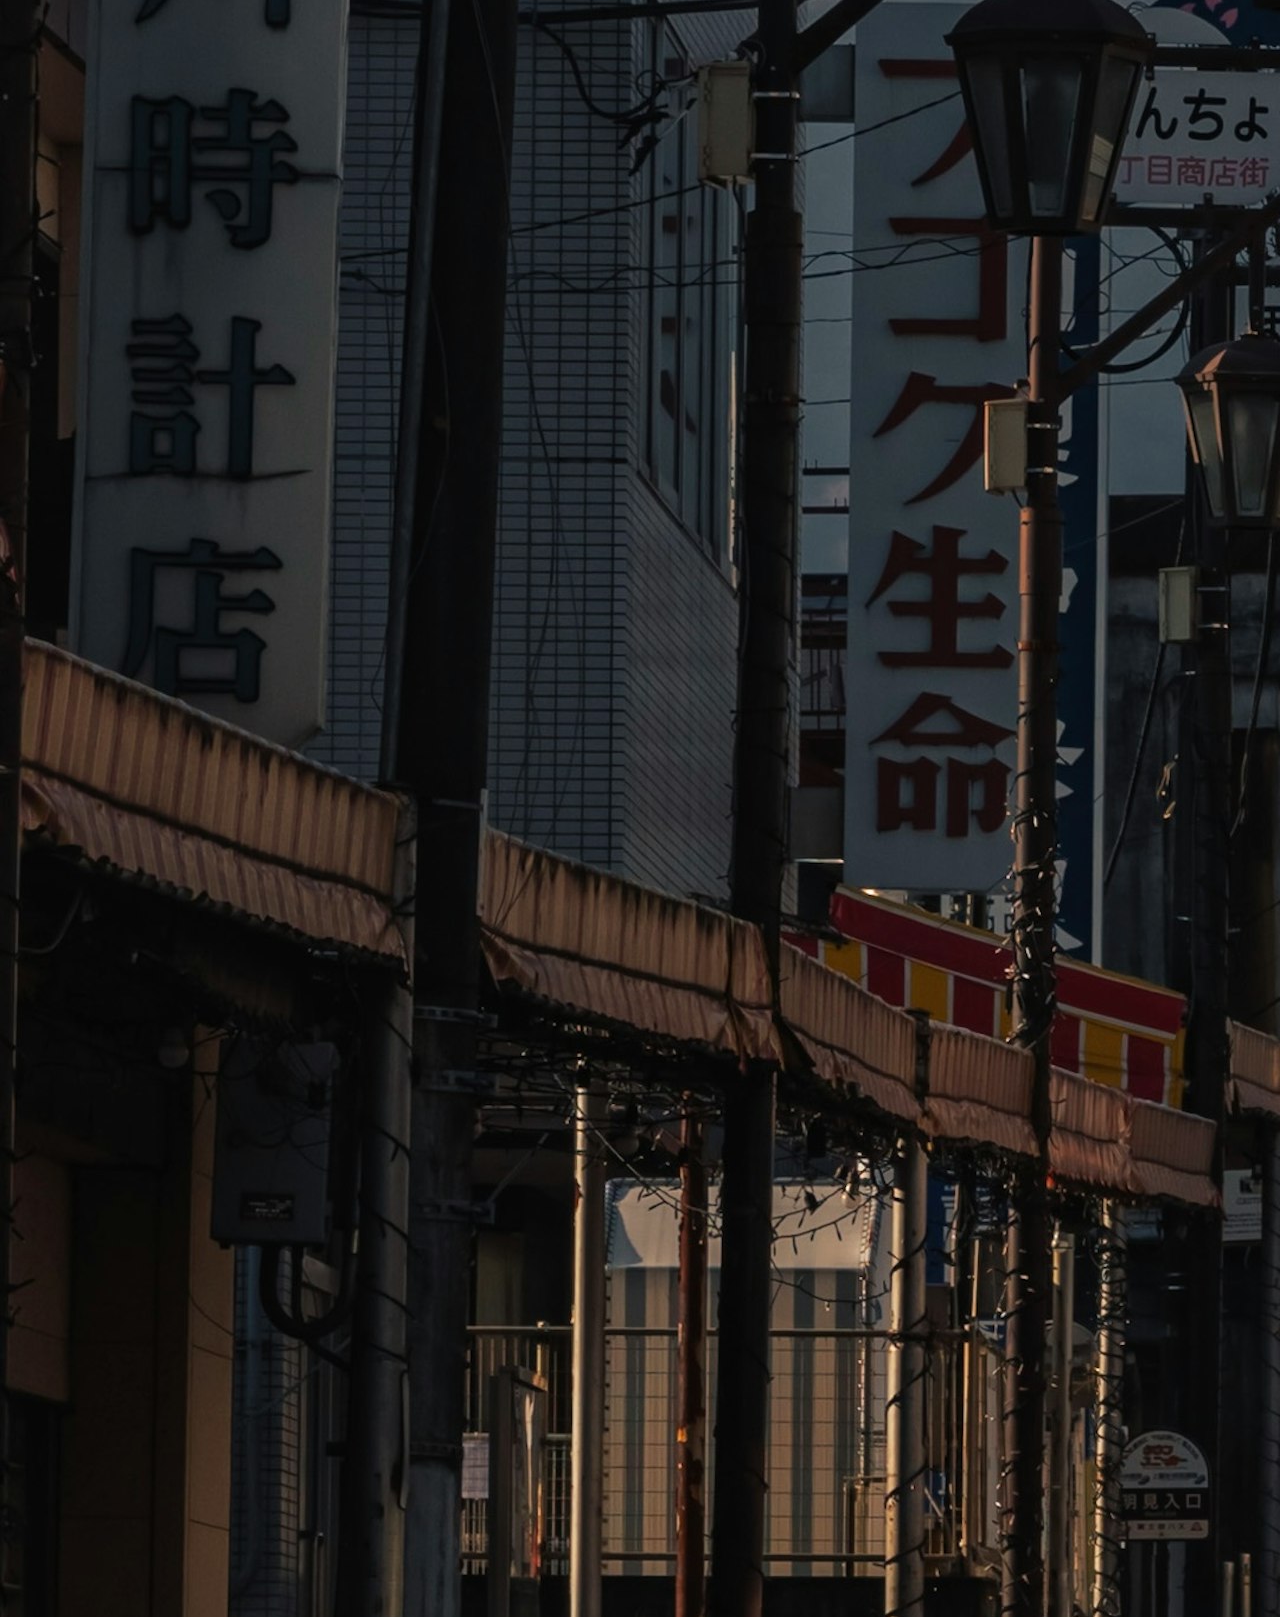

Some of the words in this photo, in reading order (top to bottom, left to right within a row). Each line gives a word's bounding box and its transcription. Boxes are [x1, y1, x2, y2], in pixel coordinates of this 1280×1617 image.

[1121, 155, 1269, 187] 丁目商店街
